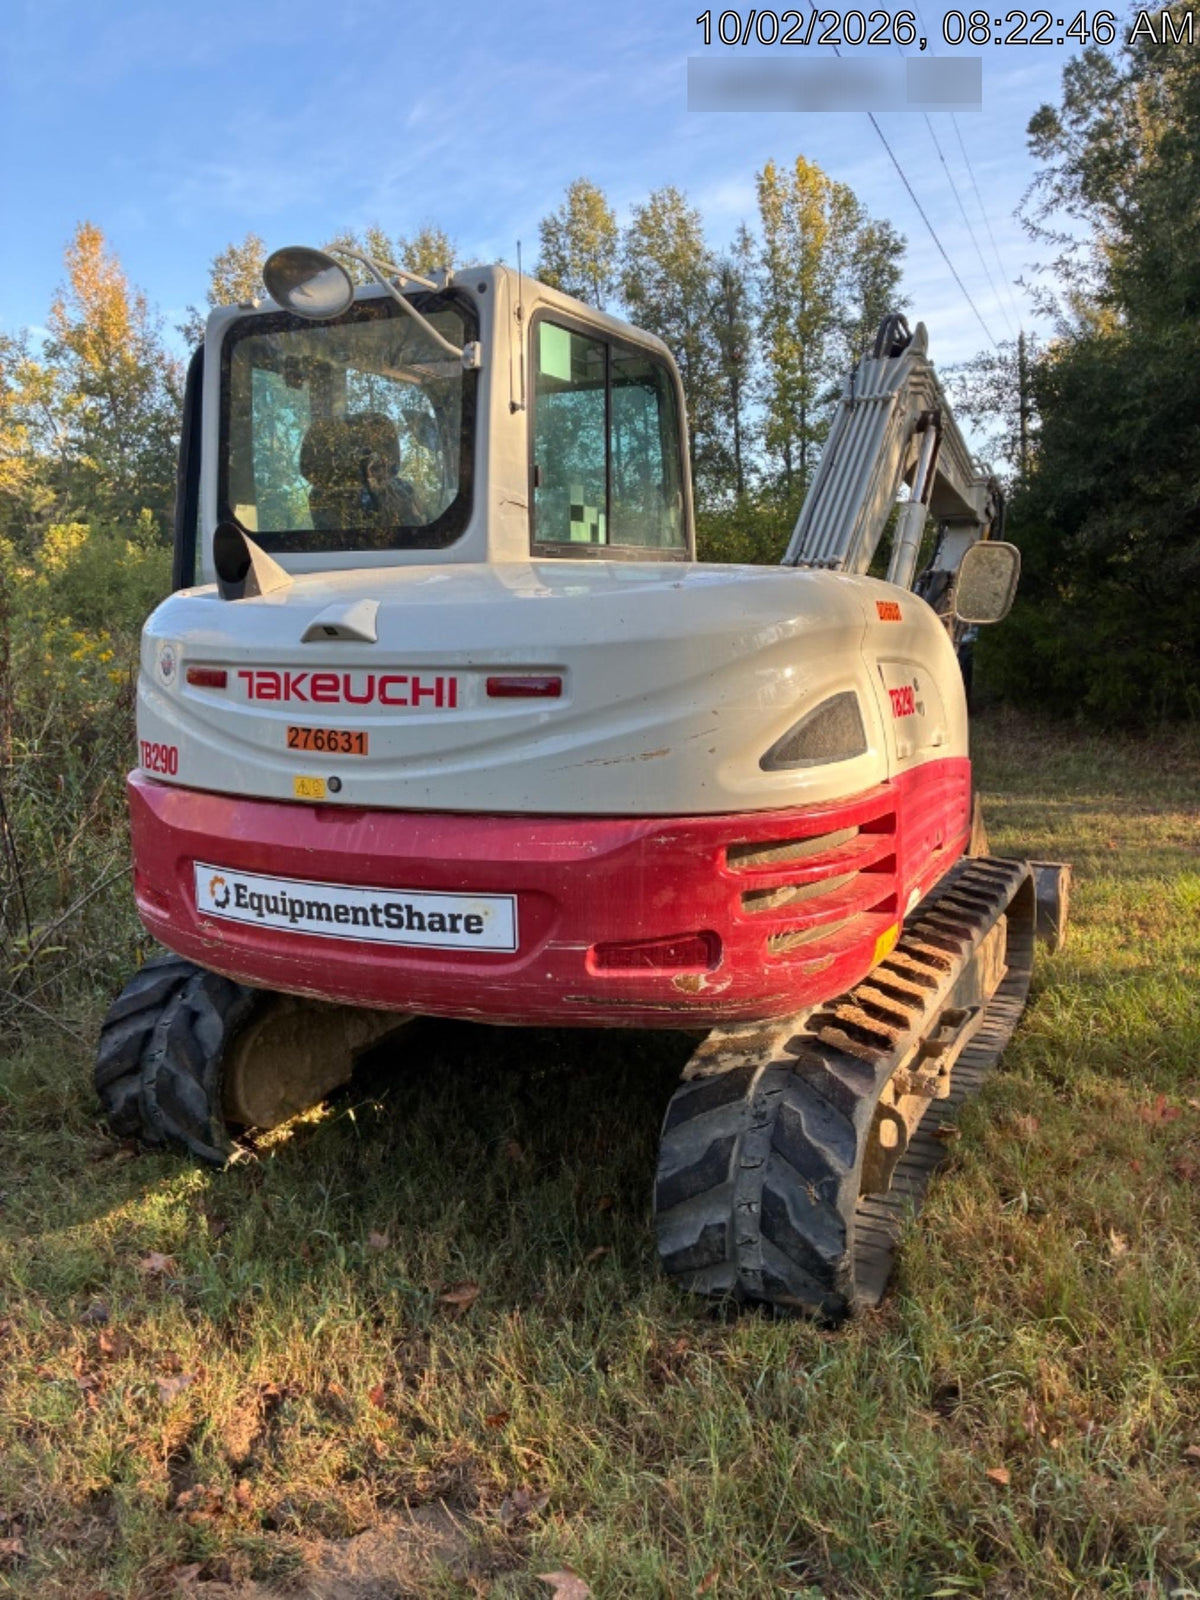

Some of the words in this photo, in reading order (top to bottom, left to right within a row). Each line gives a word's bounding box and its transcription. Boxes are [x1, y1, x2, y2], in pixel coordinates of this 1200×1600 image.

[237, 670, 458, 708] TAKEUCHI
[140, 739, 179, 776] TB290
[288, 726, 364, 754] 276631
[233, 883, 485, 935] EquipmentShare
